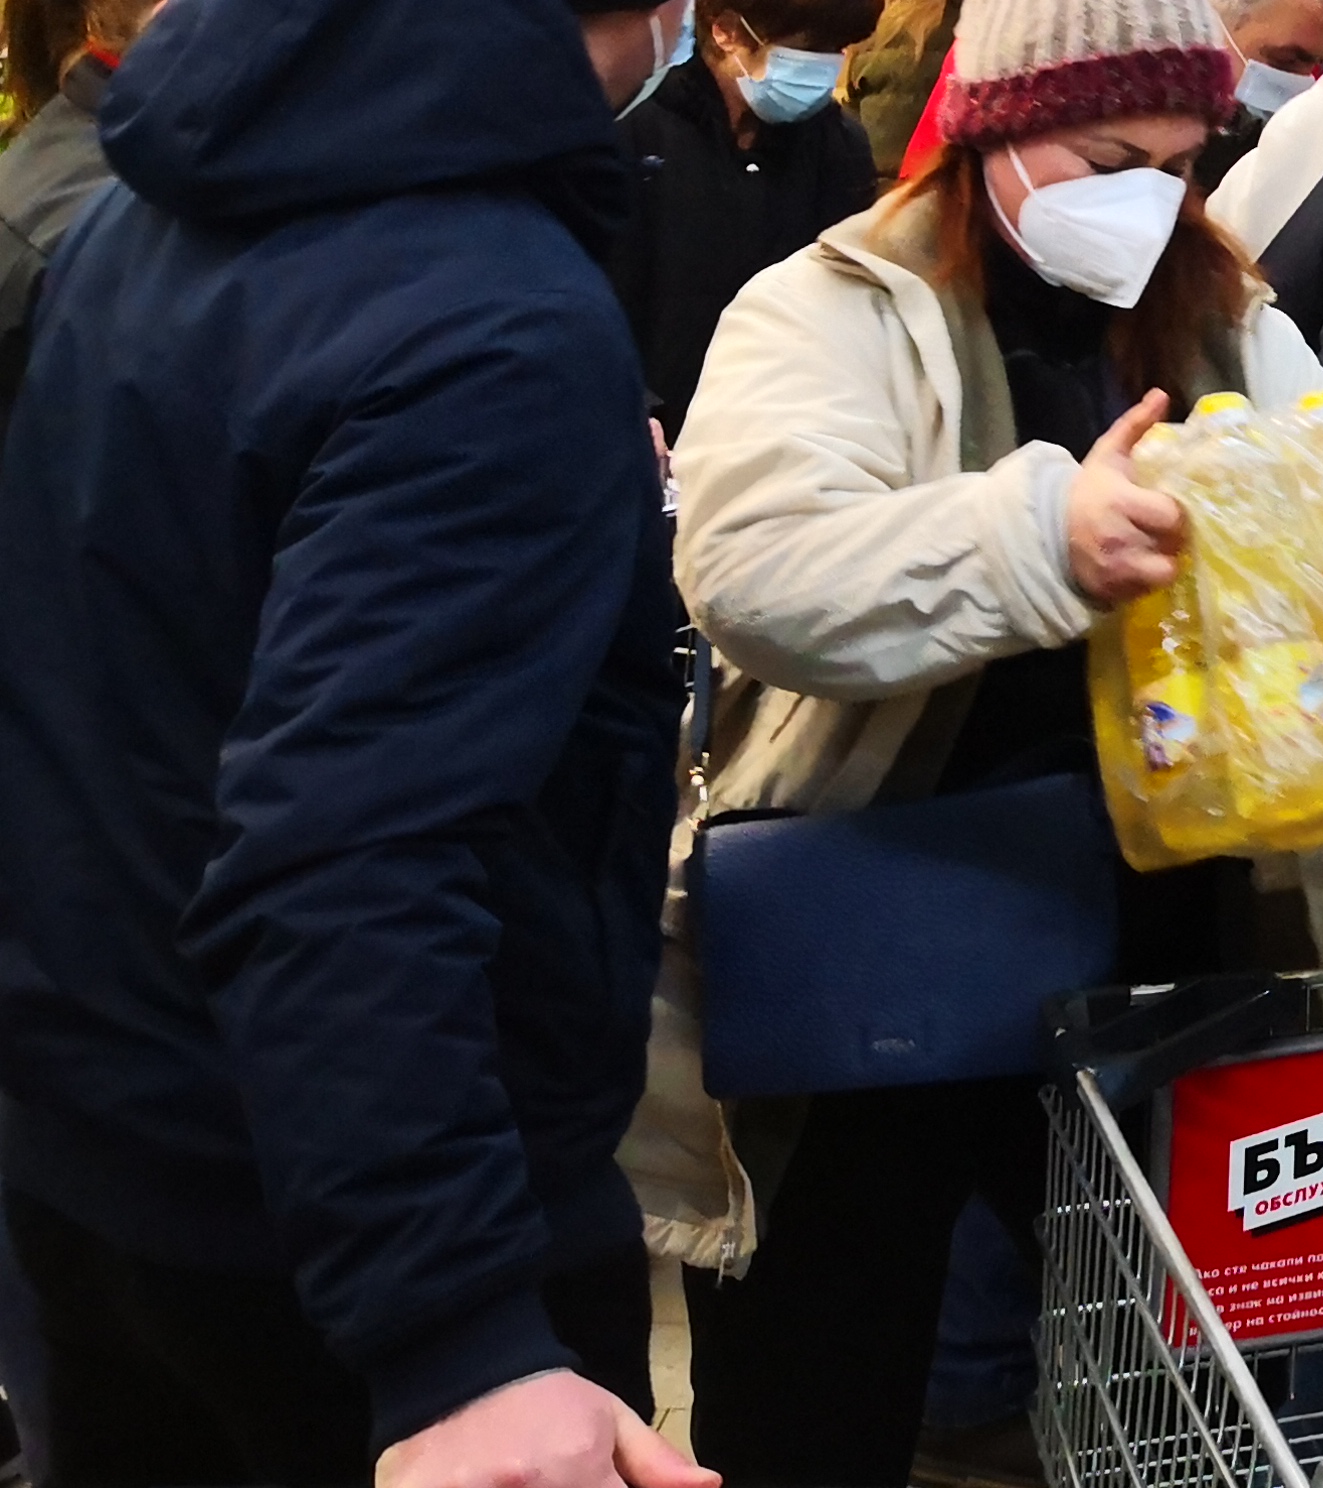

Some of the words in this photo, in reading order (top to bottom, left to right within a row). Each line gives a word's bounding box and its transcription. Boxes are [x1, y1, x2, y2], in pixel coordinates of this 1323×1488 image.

[1224, 1265, 1248, 1276] сте
[1251, 1256, 1304, 1272] чакали
[1228, 1283, 1238, 1295] и
[1241, 1280, 1259, 1292] не
[1262, 1272, 1314, 1289] всички
[1229, 1299, 1262, 1312] знак
[1266, 1295, 1284, 1307] на
[1246, 1315, 1265, 1327] на
